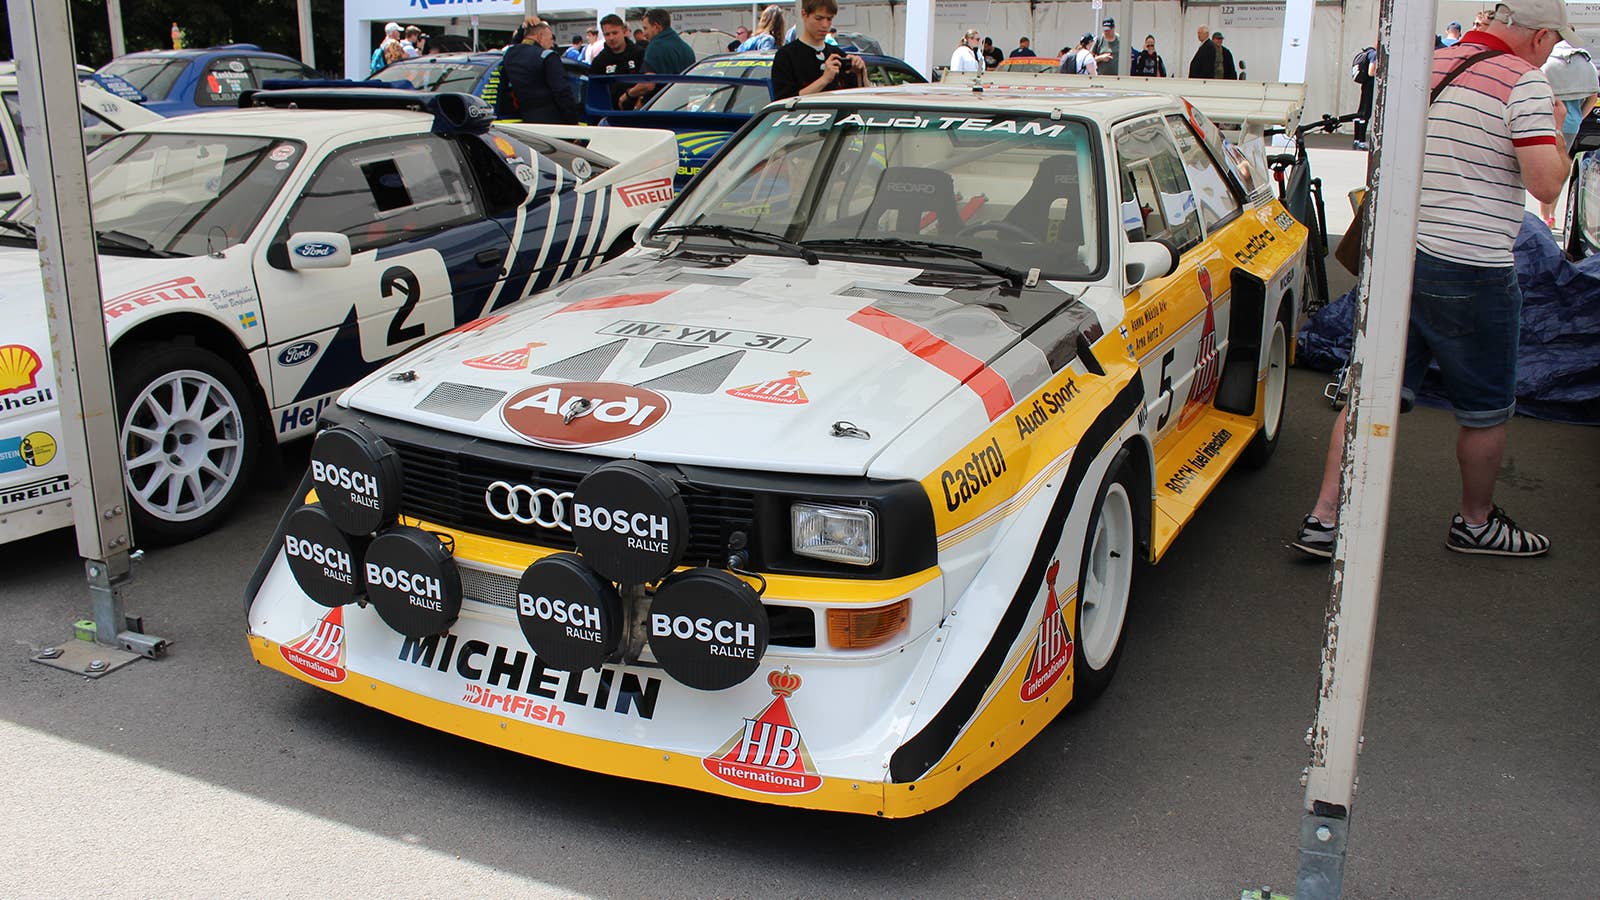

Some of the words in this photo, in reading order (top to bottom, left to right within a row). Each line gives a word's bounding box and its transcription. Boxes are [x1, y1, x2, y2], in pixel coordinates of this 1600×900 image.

[771, 112, 833, 128] HB
[833, 112, 930, 129] Audi
[938, 116, 1067, 138] TEAM
[617, 177, 673, 208] PIRELLI
[887, 182, 936, 194] RECARO
[301, 243, 329, 257] Ford
[1234, 229, 1276, 266] quattro
[379, 265, 426, 347] 2
[284, 343, 313, 364] Ford
[743, 333, 788, 350] 31
[750, 380, 803, 397] HB
[1156, 346, 1176, 433] 5
[508, 387, 657, 427] Audi
[1014, 399, 1049, 441] Audi
[1041, 377, 1081, 414] Sport
[311, 459, 379, 498] BOSCH
[941, 436, 1007, 513] Castrol
[1164, 464, 1200, 495] BOSCH
[350, 491, 380, 510] RALLYE
[573, 502, 670, 541] BOSCH
[285, 534, 352, 574] BOSCH
[627, 536, 670, 554] RALLYE
[323, 566, 353, 585] RALLYE
[365, 562, 442, 600] BOSCH
[409, 594, 444, 612] RALLYE
[518, 592, 602, 630] BOSCH
[298, 618, 346, 661] HB
[565, 626, 602, 643] RALLYE
[651, 612, 756, 647] BOSCH
[1036, 607, 1062, 675] HB
[287, 650, 338, 679] international
[709, 644, 756, 660] RALLYE
[397, 633, 663, 721] MICHELIN
[1027, 649, 1068, 696] international
[462, 682, 566, 727] DirtFish
[736, 717, 802, 770] HB
[717, 762, 806, 788] international
